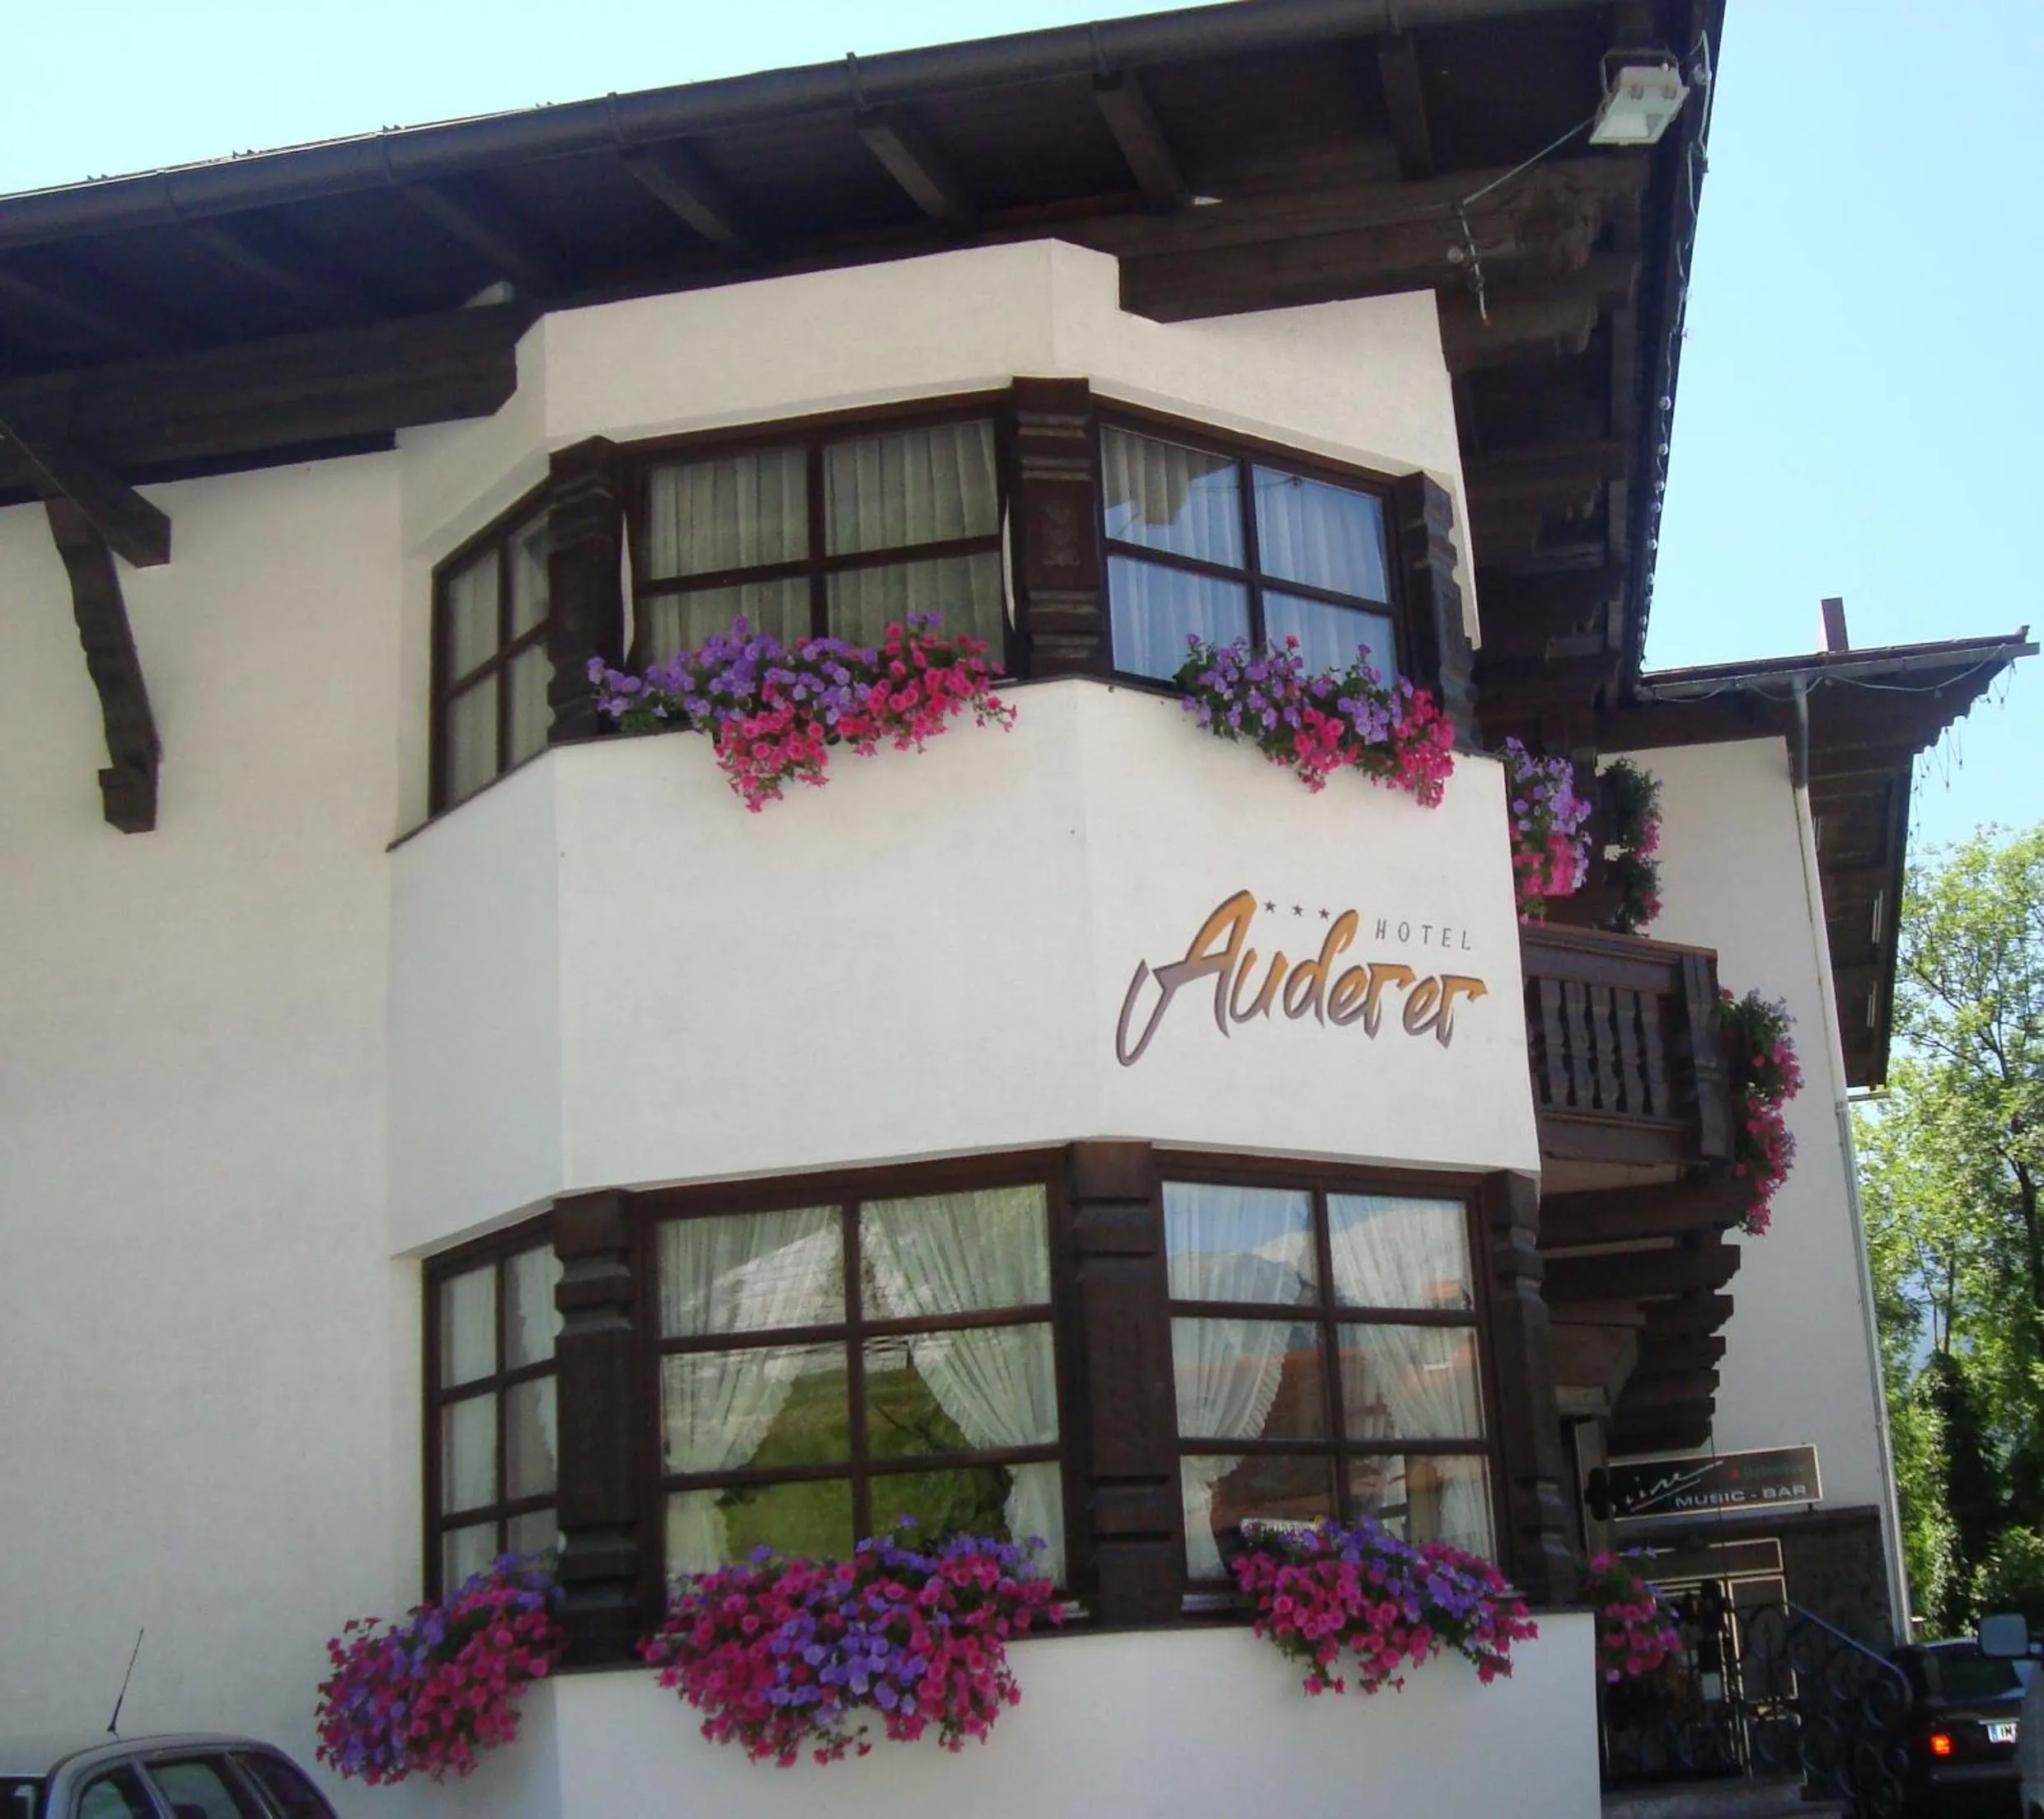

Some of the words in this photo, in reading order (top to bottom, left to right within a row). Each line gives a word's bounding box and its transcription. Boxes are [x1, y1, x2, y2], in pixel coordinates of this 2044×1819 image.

[1375, 918, 1472, 950] HOTEL
[1116, 888, 1488, 1067] Auderer
[1762, 1484, 1807, 1499] BAR
